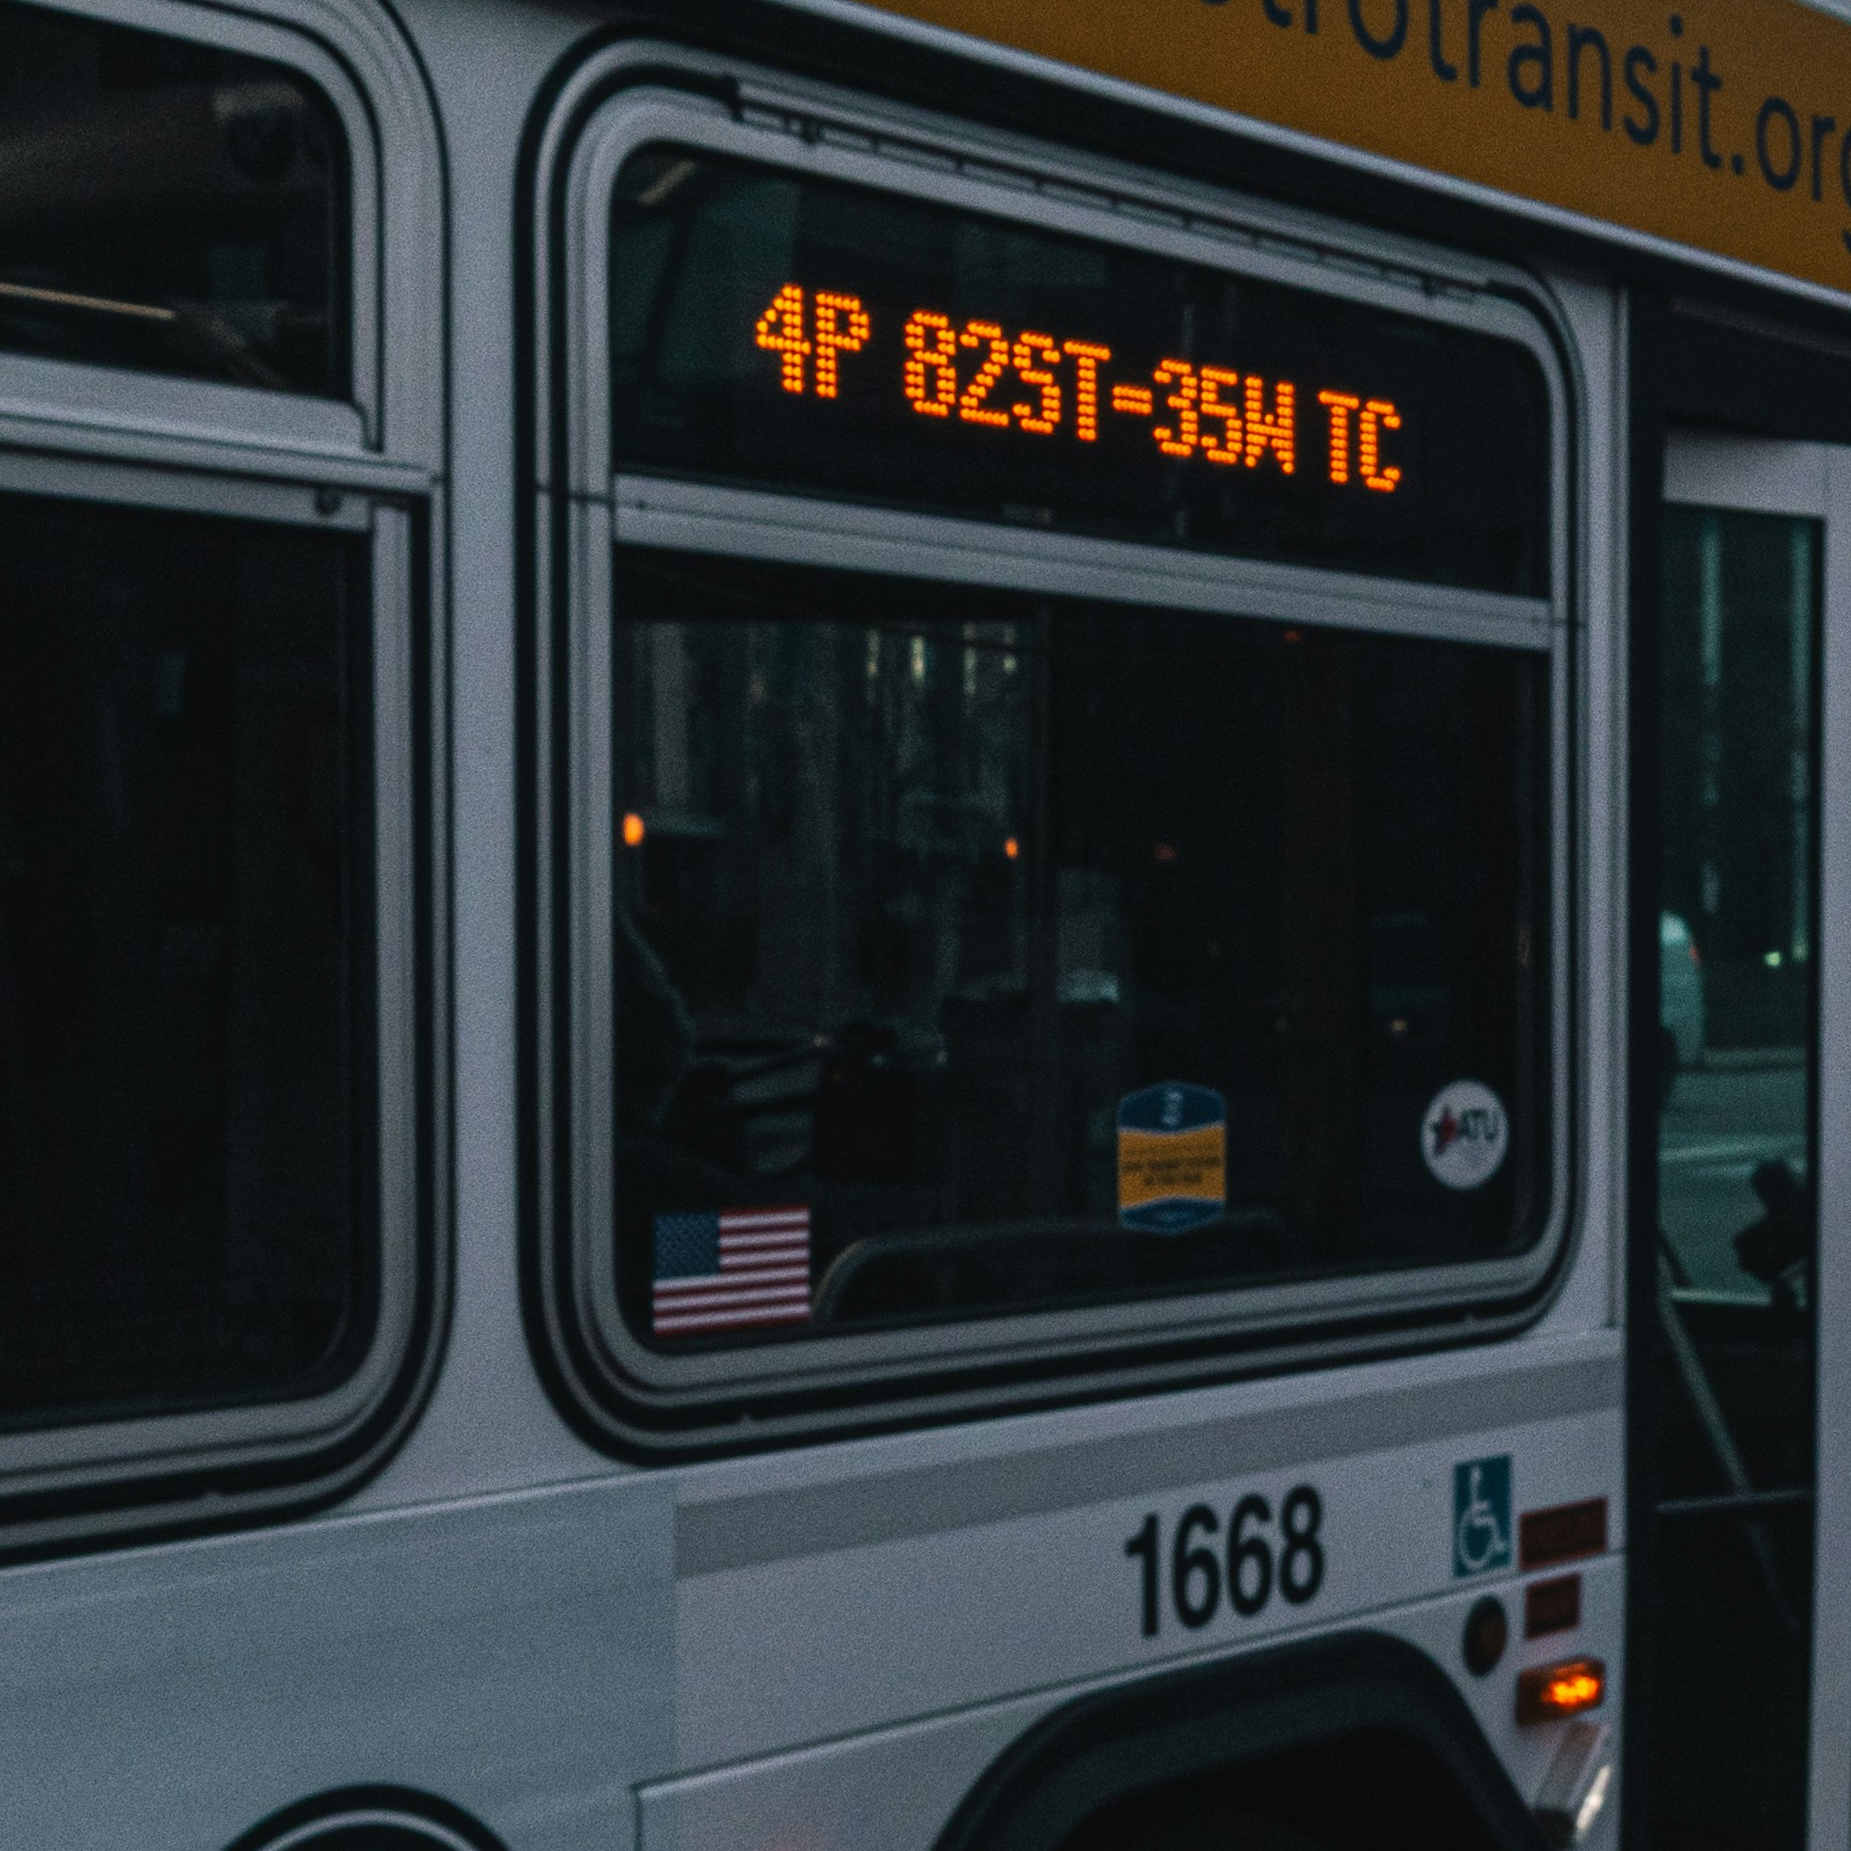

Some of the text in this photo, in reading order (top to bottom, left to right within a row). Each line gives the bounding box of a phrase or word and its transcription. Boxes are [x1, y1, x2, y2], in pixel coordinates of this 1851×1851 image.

[756, 283, 1401, 492] 4P 82ST-35W TC
[1126, 1485, 1326, 1639] 1668
